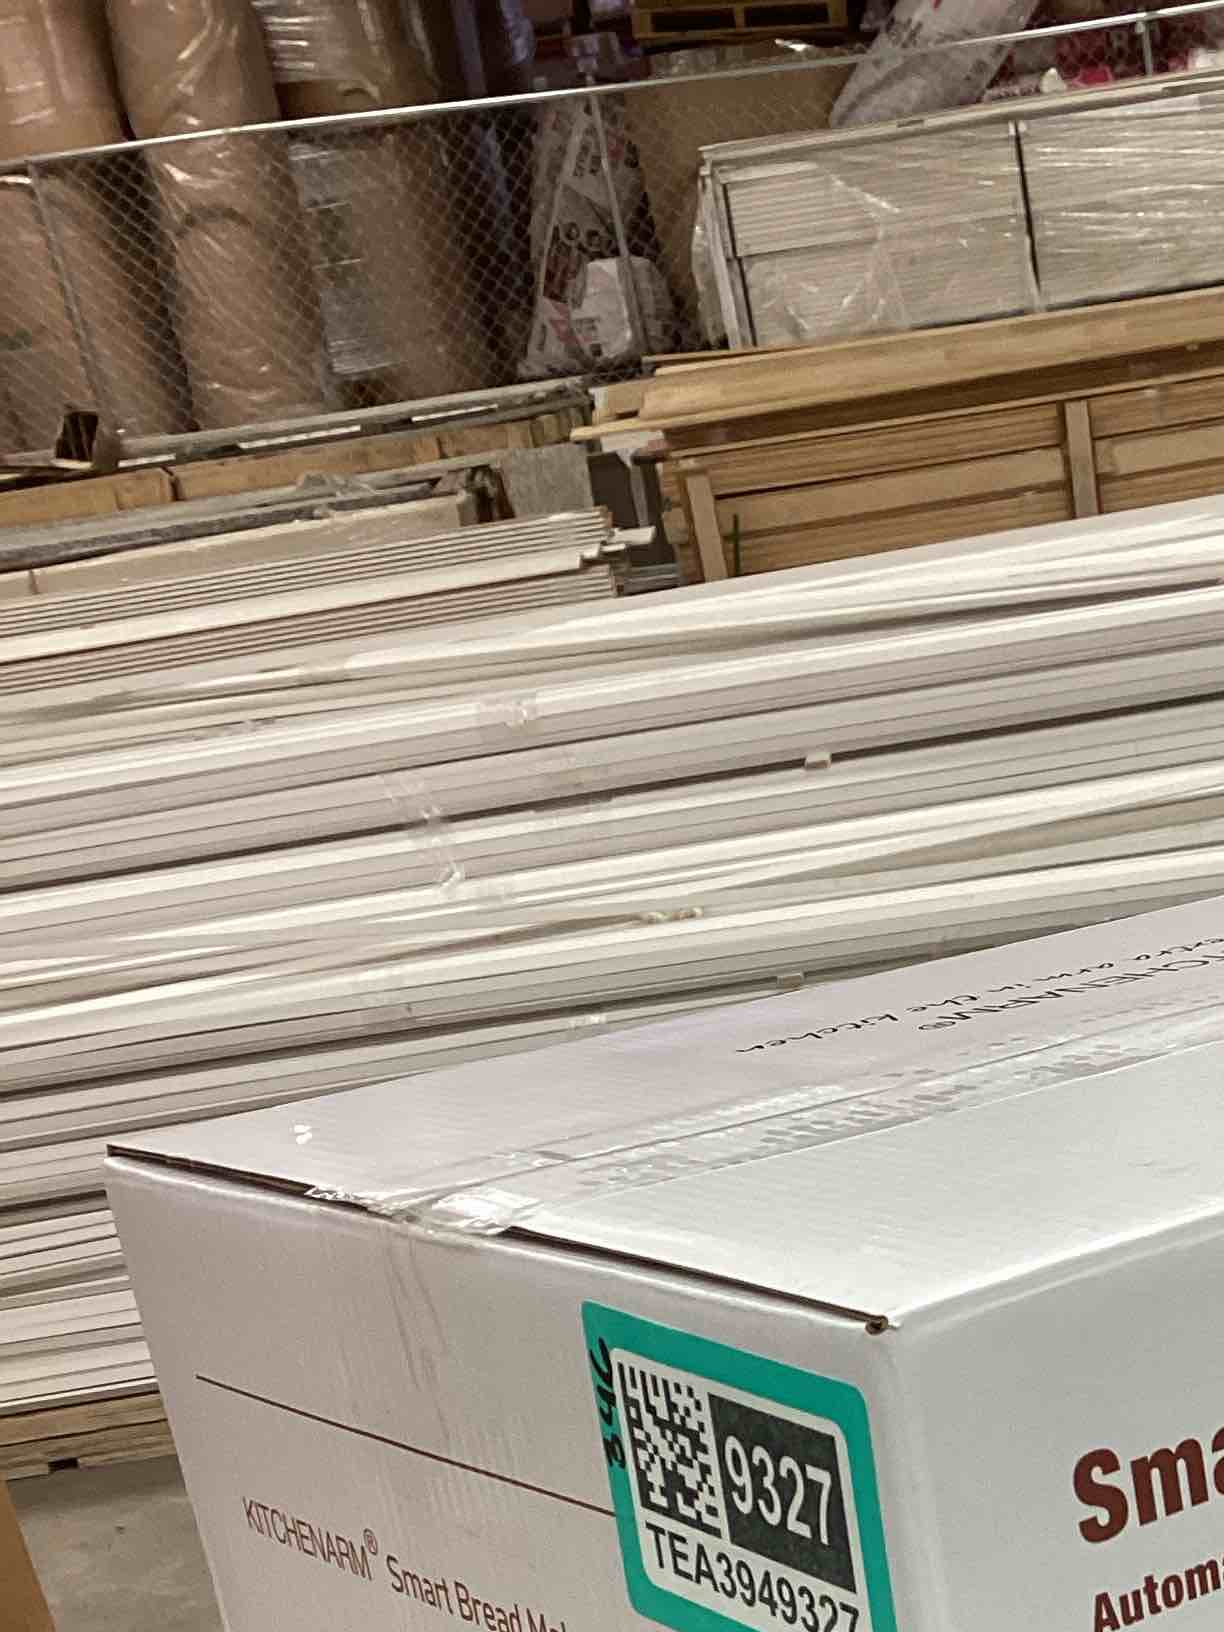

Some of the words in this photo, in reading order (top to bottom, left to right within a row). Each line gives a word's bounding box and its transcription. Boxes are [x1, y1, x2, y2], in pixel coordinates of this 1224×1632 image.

[1136, 937, 1224, 962] extra
[1035, 960, 1114, 983] arm
[905, 993, 978, 1013] the
[735, 1012, 897, 1053] kitchen
[724, 1435, 835, 1547] 9327
[386, 1554, 451, 1611] Smart
